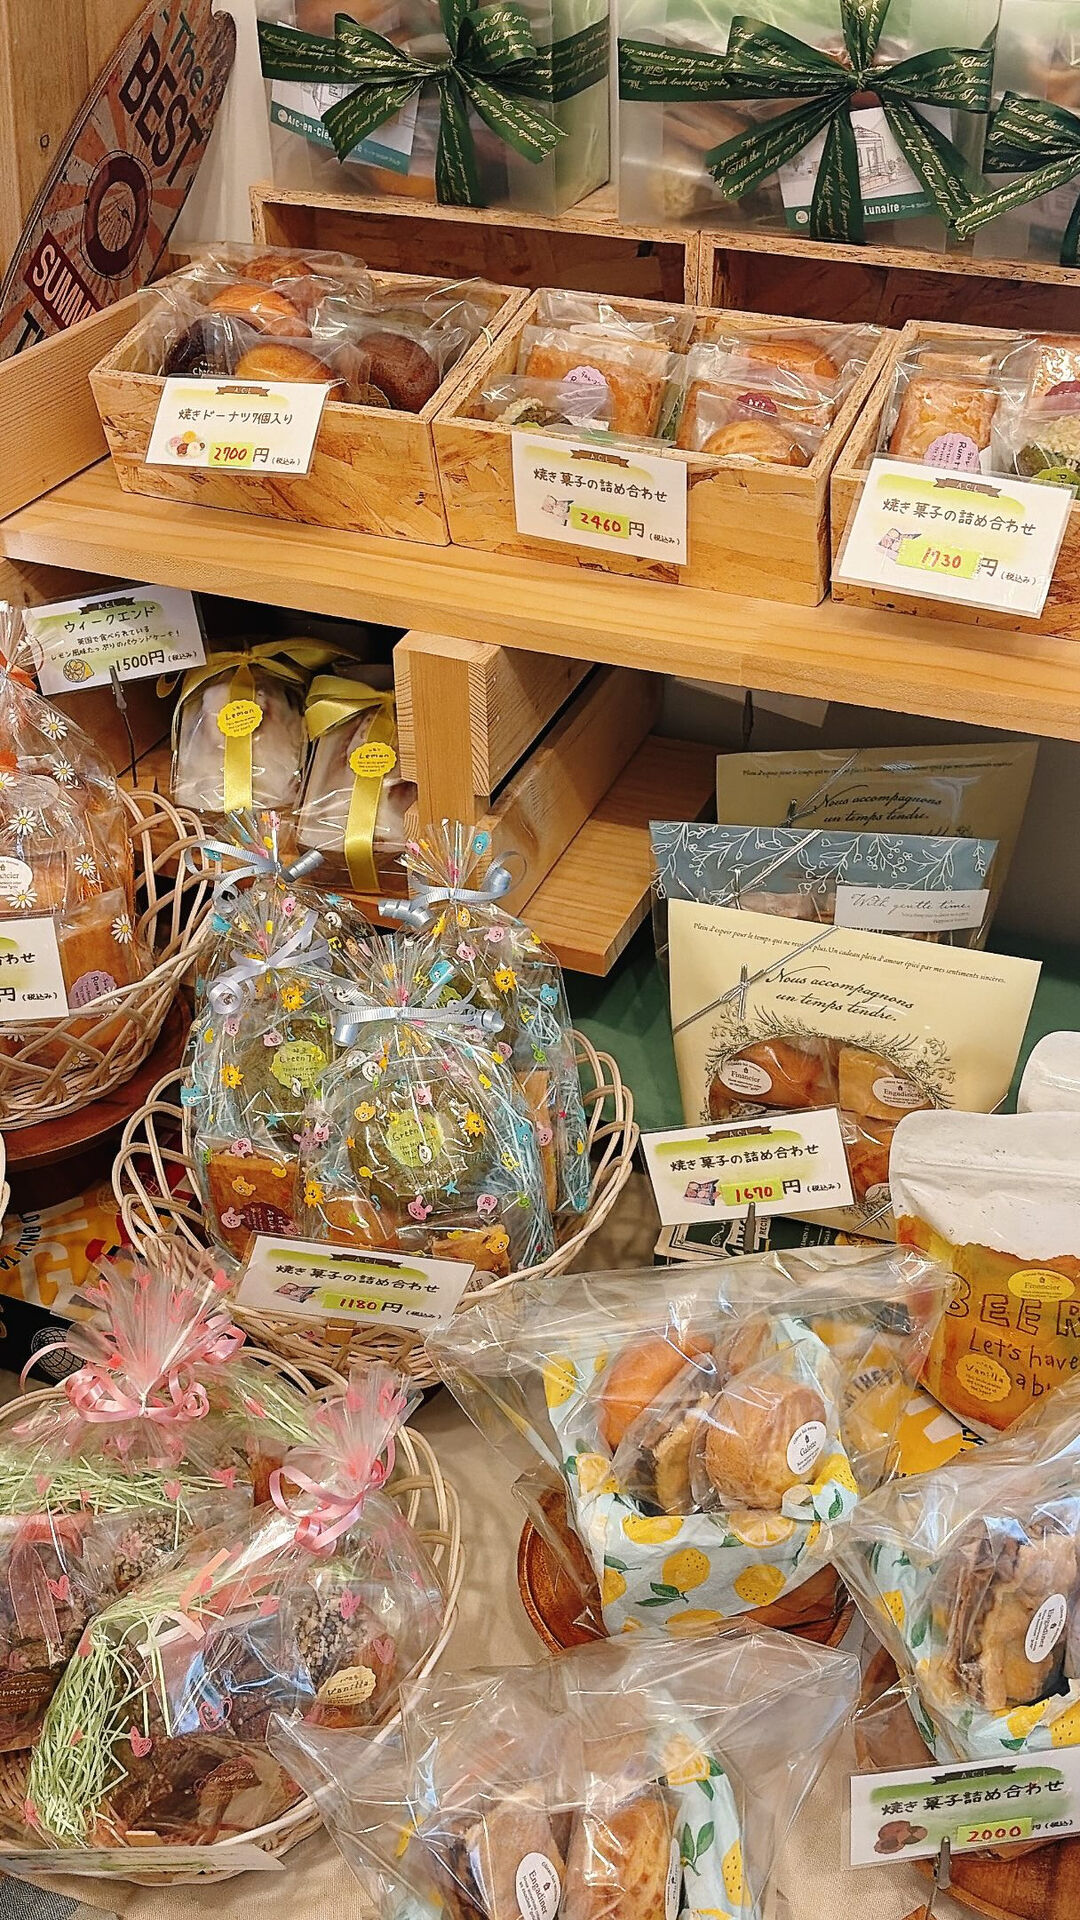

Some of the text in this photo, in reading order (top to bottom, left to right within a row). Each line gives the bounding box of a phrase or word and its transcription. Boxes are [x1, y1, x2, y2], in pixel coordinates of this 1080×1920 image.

[171, 12, 204, 97] The
[119, 32, 206, 186] BEST
[288, 113, 332, 141] Arc-en-Cie
[864, 203, 900, 216] Lunaire
[178, 408, 294, 425] 焼きドーナツ7個入り
[213, 447, 248, 462] 2700
[252, 447, 270, 464] 円
[533, 467, 668, 503] 焼き菓子の詰め合わせ
[580, 512, 622, 533] 2460
[628, 521, 645, 538] 円
[882, 497, 1037, 537] 焼き菓子の詰め合わせ
[921, 547, 962, 570] 1730
[64, 606, 157, 633] ウィークエンド
[225, 708, 255, 721] Lemon
[358, 752, 390, 760] Lemon
[852, 792, 943, 812] accompagnons
[824, 813, 845, 823] un
[845, 810, 883, 827] temps
[851, 893, 891, 910] With
[893, 900, 934, 915] gentle
[693, 922, 708, 932] Plein
[860, 951, 876, 961] plein
[919, 963, 933, 973] par
[933, 966, 945, 974] mes
[811, 979, 915, 1009] accompagnons
[776, 993, 898, 1022] un temps tendre.
[730, 1069, 762, 1083] Financier
[670, 1144, 819, 1173] 焼き菓子の詰め合わせ
[735, 1185, 773, 1203] 1670
[782, 1179, 801, 1194] 円
[17, 1225, 42, 1256] ONLY
[276, 1264, 440, 1293] 焼き菓子の詰め合わせ
[340, 1298, 378, 1311] 1180
[381, 1301, 404, 1313] 円
[945, 1271, 1080, 1339] BEER
[969, 1327, 1080, 1371] Let's have
[965, 1363, 1005, 1384] Vanilla
[327, 1680, 369, 1696] Vanilla
[881, 1780, 1065, 1816] 焼き菓子詰め合わせ
[966, 1826, 1021, 1843] 2000
[528, 1869, 548, 1915] Engadiner
